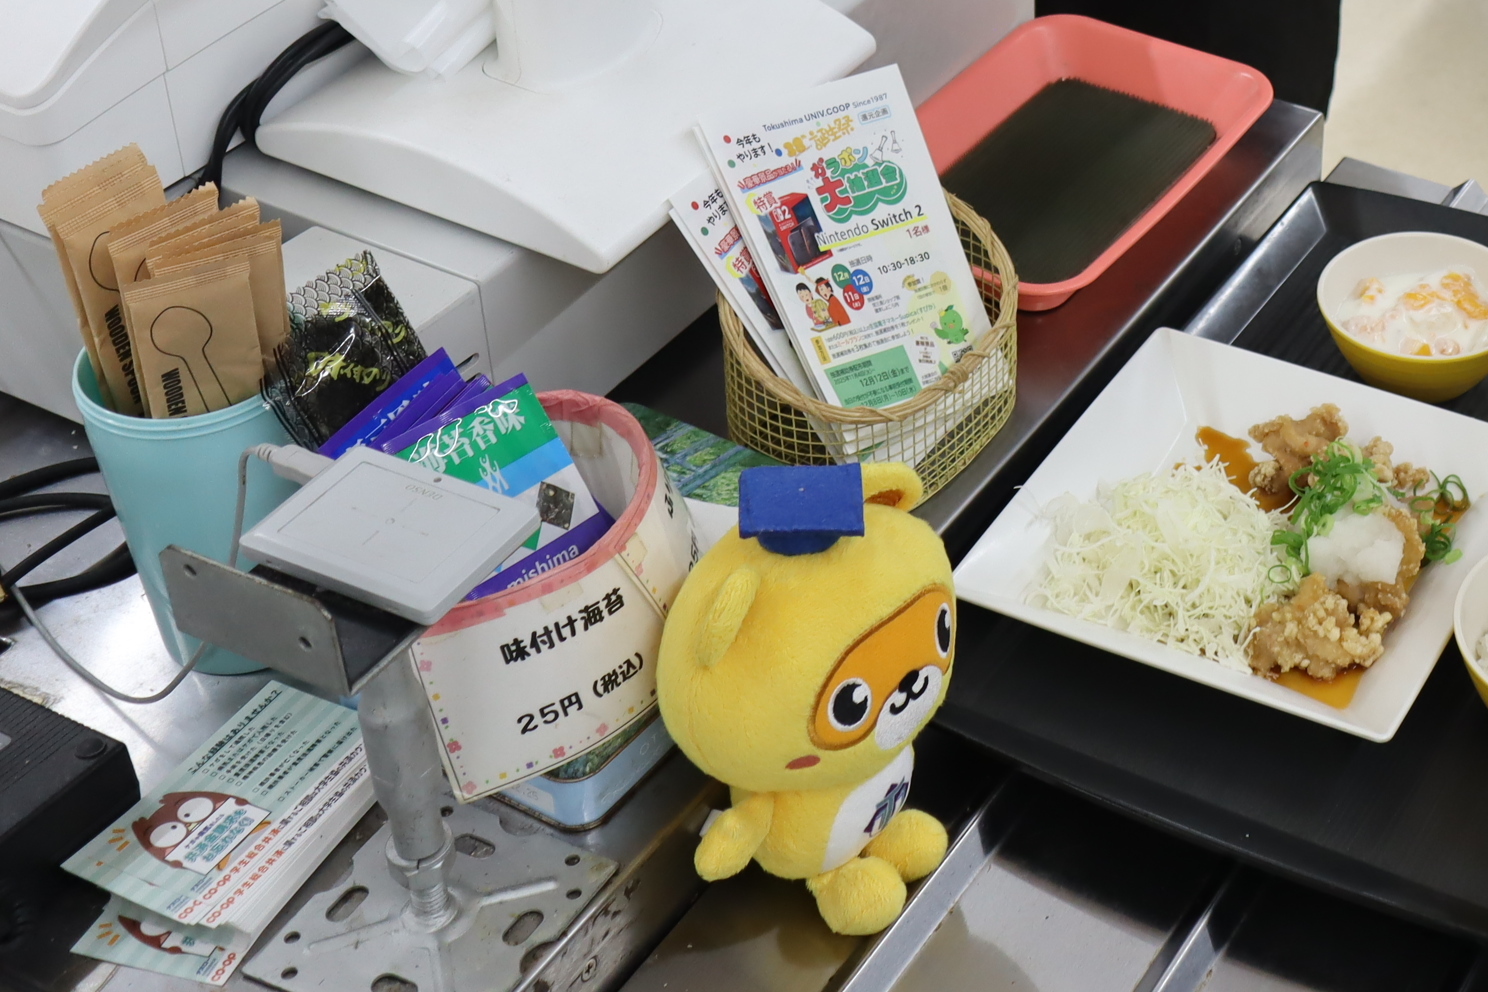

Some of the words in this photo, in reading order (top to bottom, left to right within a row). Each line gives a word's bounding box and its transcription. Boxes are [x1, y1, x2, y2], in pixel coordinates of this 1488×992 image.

[762, 116, 803, 134] Tokushima
[803, 101, 851, 122] UNIV.COOP
[851, 92, 888, 109] Since1987
[734, 131, 761, 148] 今年も
[752, 190, 779, 214] 特賞
[816, 220, 869, 247] Nintendo
[871, 208, 912, 232] Switch
[914, 204, 925, 219] 2
[906, 223, 930, 239] 1名様
[877, 251, 930, 274] 10:30-18:30
[104, 304, 132, 363] WOODEN
[161, 367, 188, 417] WOODEN
[404, 483, 444, 502] DENSO
[506, 544, 580, 590] mishima
[499, 587, 626, 666] 味付け海苔
[516, 691, 584, 735] 25円
